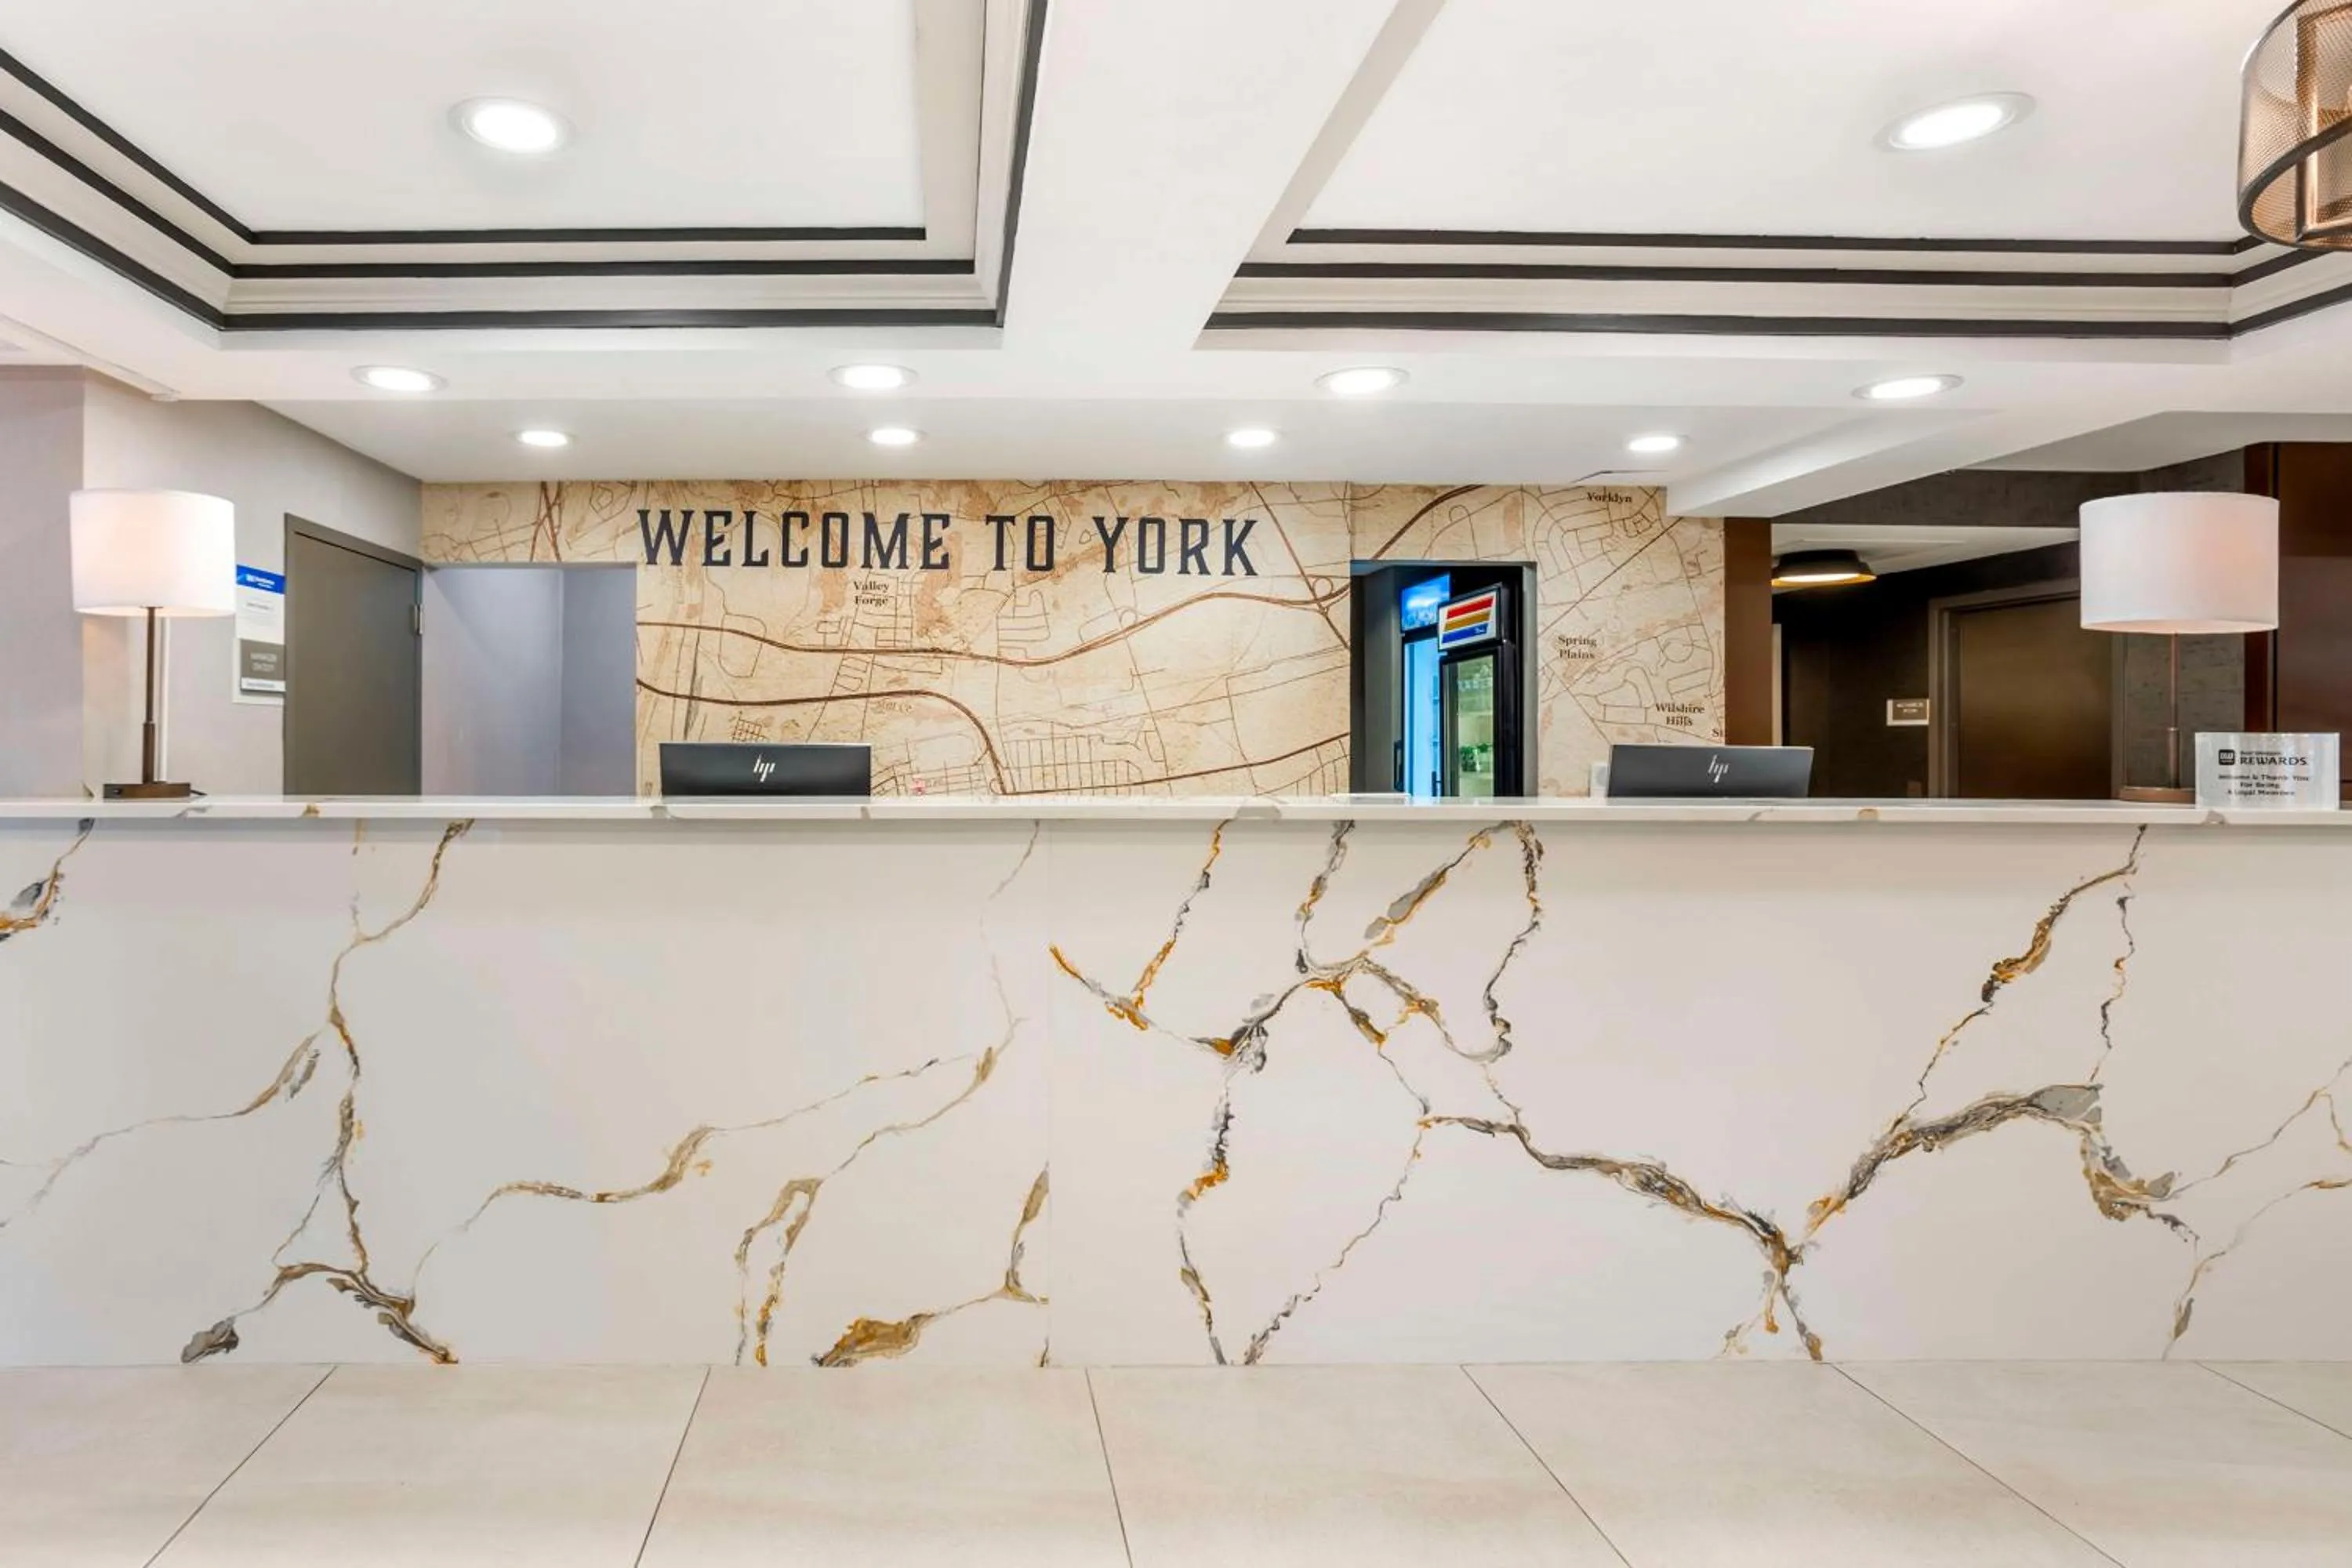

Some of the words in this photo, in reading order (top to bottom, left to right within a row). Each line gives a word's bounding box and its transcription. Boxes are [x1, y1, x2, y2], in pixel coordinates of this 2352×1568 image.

[637, 510, 950, 569] WELCOME
[985, 515, 1054, 572] TO
[1092, 517, 1258, 576] YORK
[853, 581, 890, 593] Valley
[855, 595, 888, 607] Forge
[1558, 635, 1597, 648] Spring
[1559, 648, 1595, 659] Plains
[1655, 702, 1705, 713] Wilshire
[1666, 716, 1693, 726] Hills
[2240, 757, 2308, 765] REWARDS
[753, 753, 775, 782] hp
[1708, 754, 1729, 783] hp
